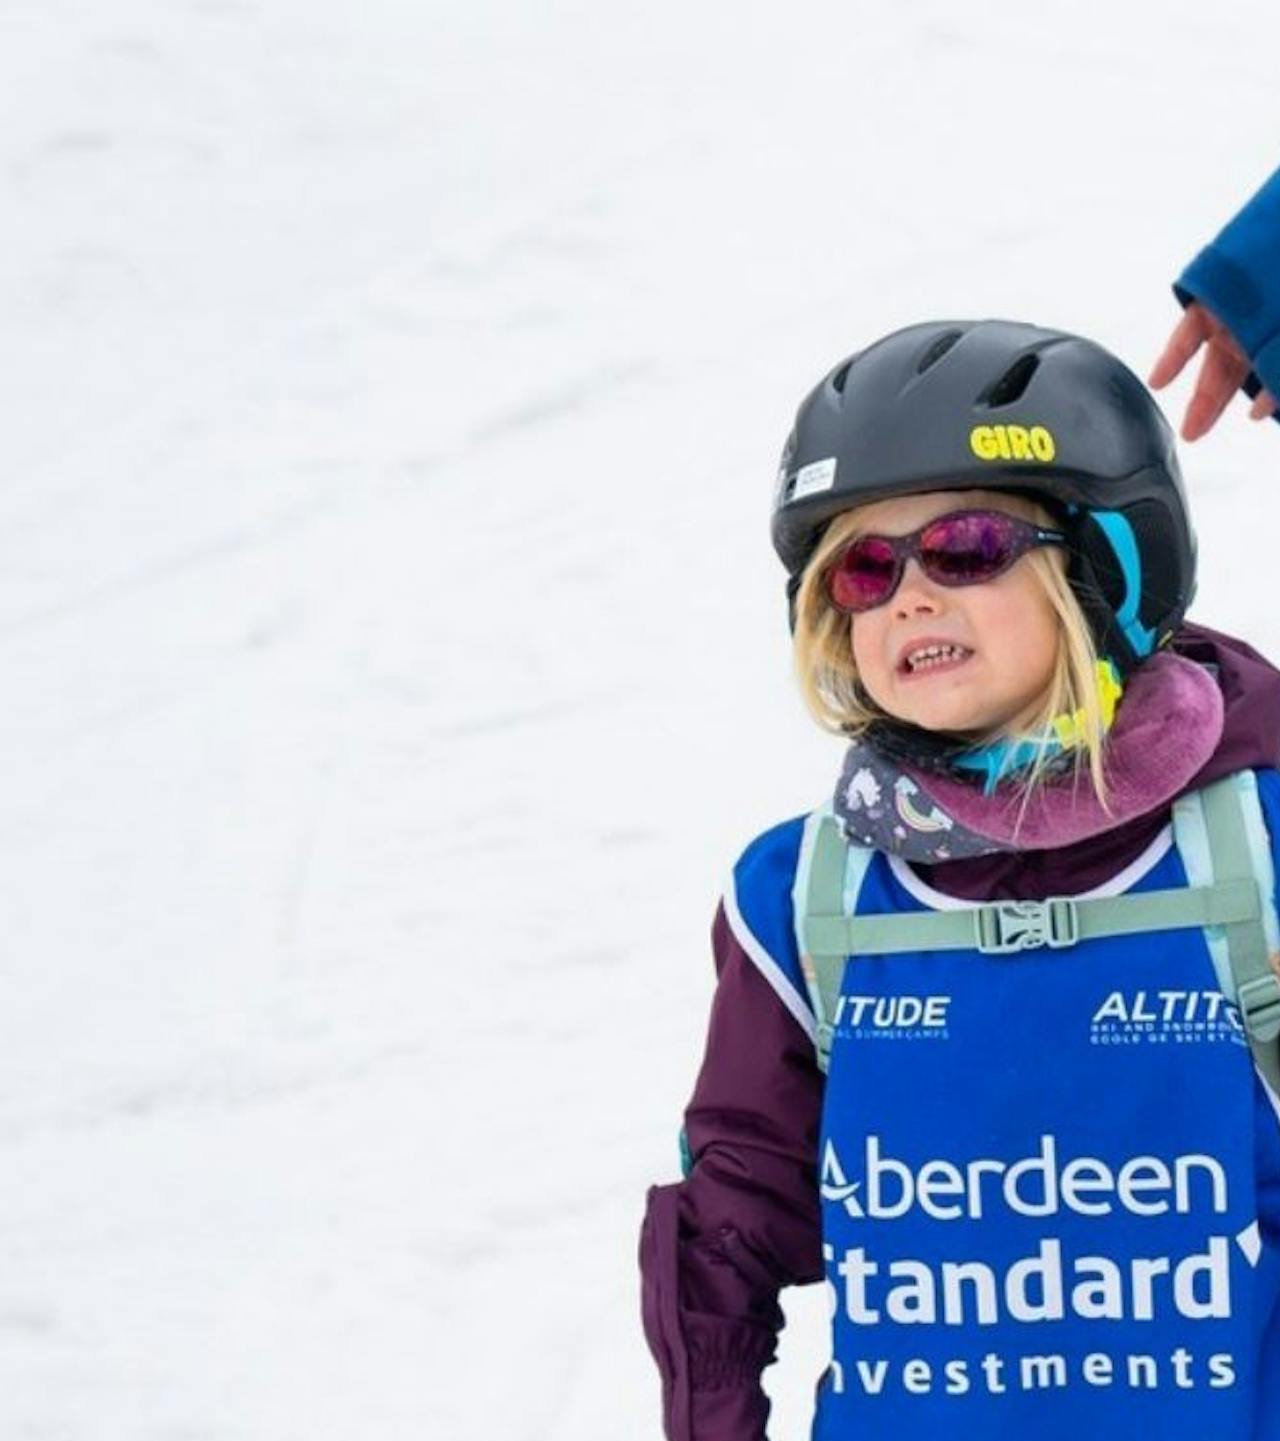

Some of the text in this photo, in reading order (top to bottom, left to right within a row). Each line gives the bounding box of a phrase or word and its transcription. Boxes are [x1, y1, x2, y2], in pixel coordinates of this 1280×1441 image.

[970, 424, 1055, 462] GIRO
[833, 996, 951, 1027] ITUDE
[1092, 991, 1243, 1031] ALTIT
[821, 1135, 1227, 1220] Aberdeen
[823, 1236, 1232, 1324] tandard
[830, 1348, 1236, 1394] nvestments
